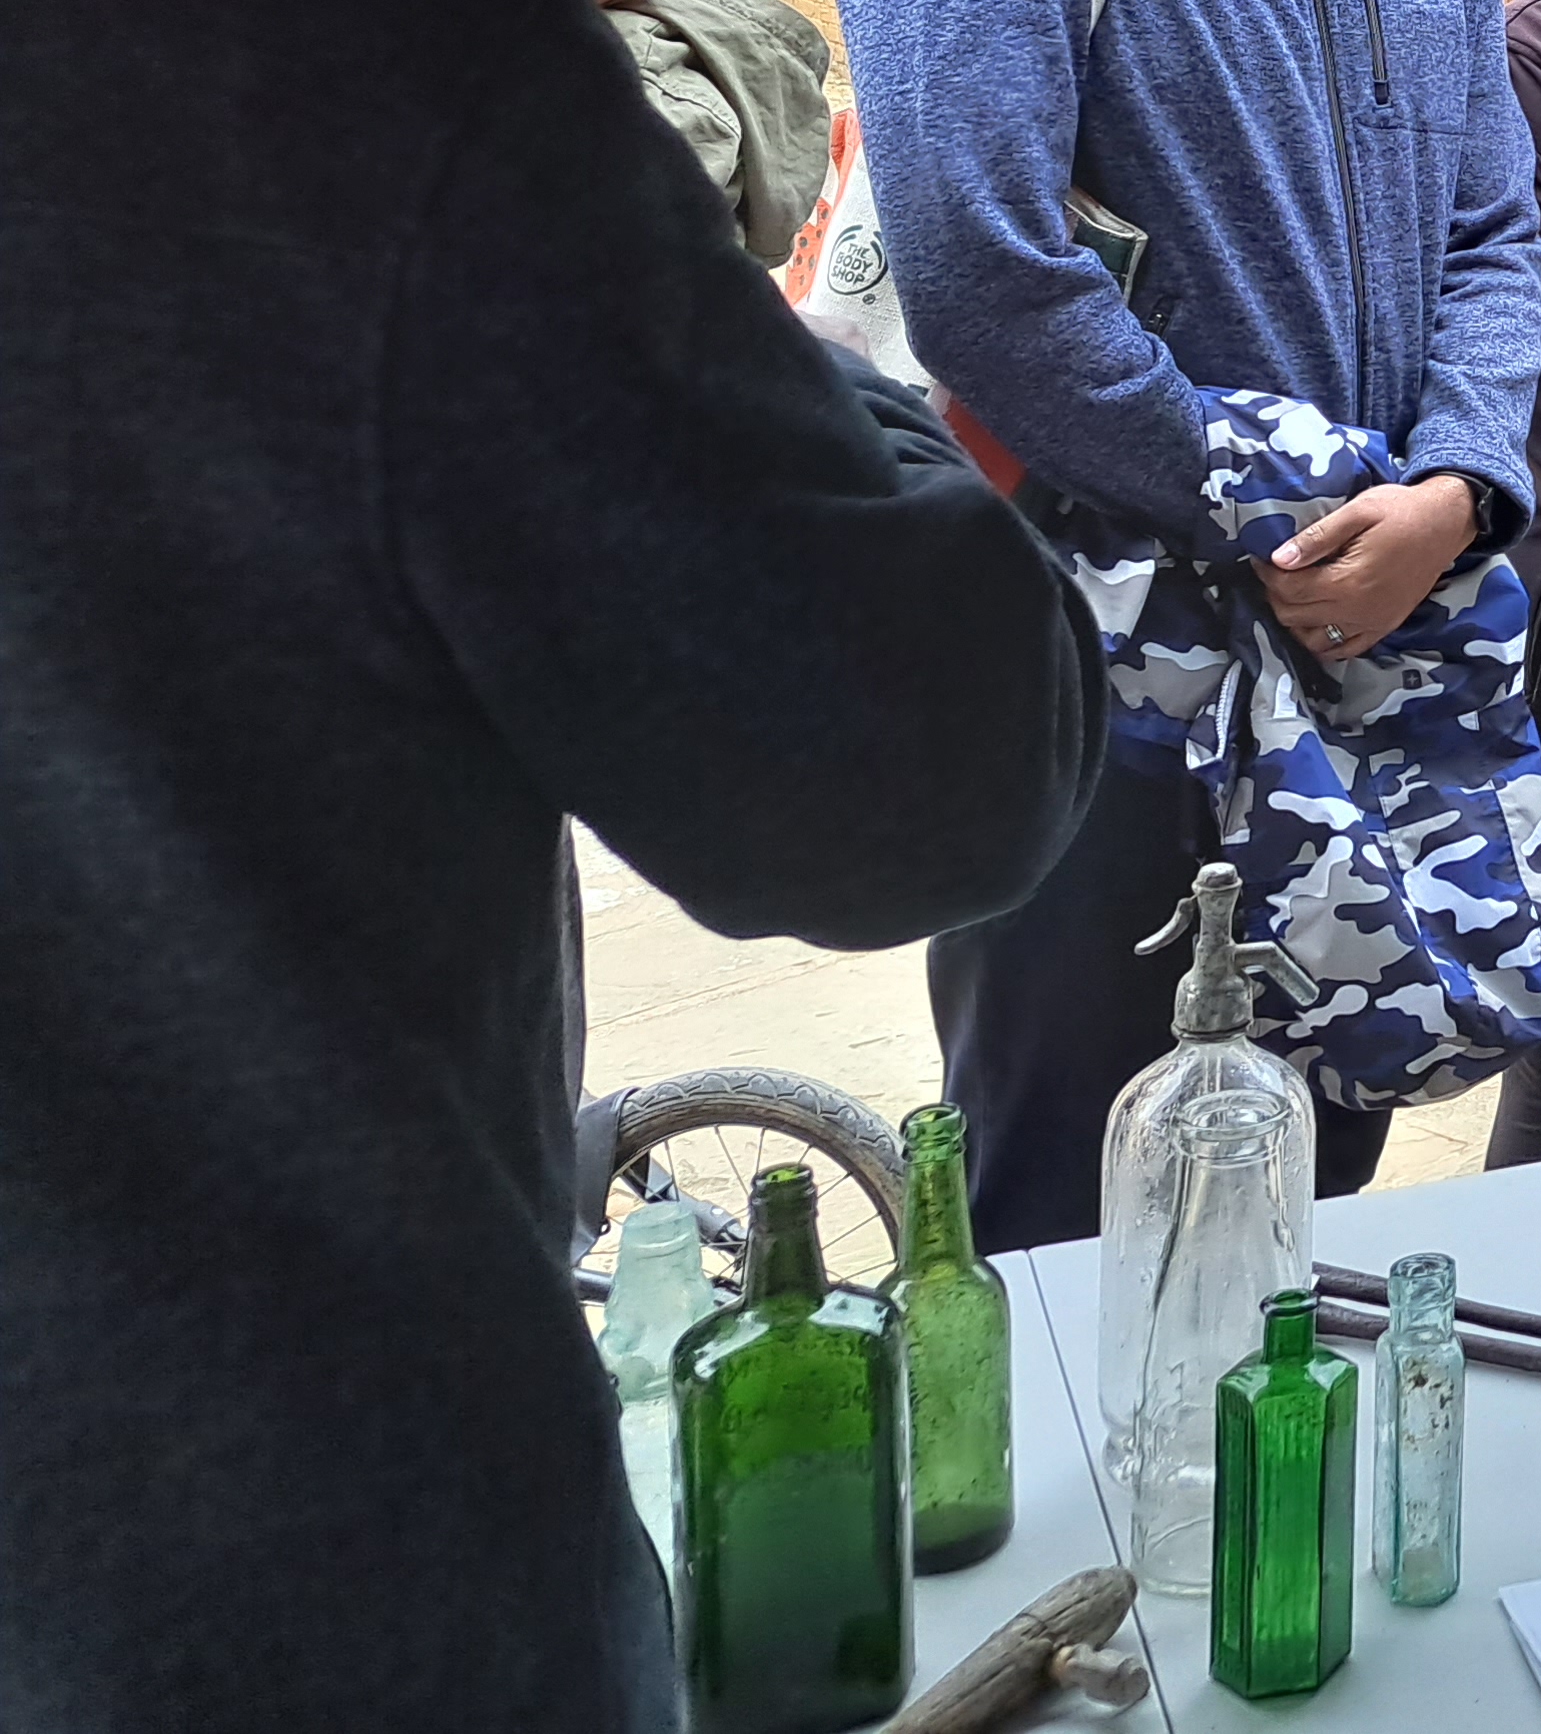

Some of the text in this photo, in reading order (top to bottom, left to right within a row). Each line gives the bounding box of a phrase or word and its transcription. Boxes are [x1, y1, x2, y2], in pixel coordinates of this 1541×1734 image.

[848, 243, 870, 258] THE
[835, 252, 873, 273] BODY
[831, 265, 865, 285] SHOP
